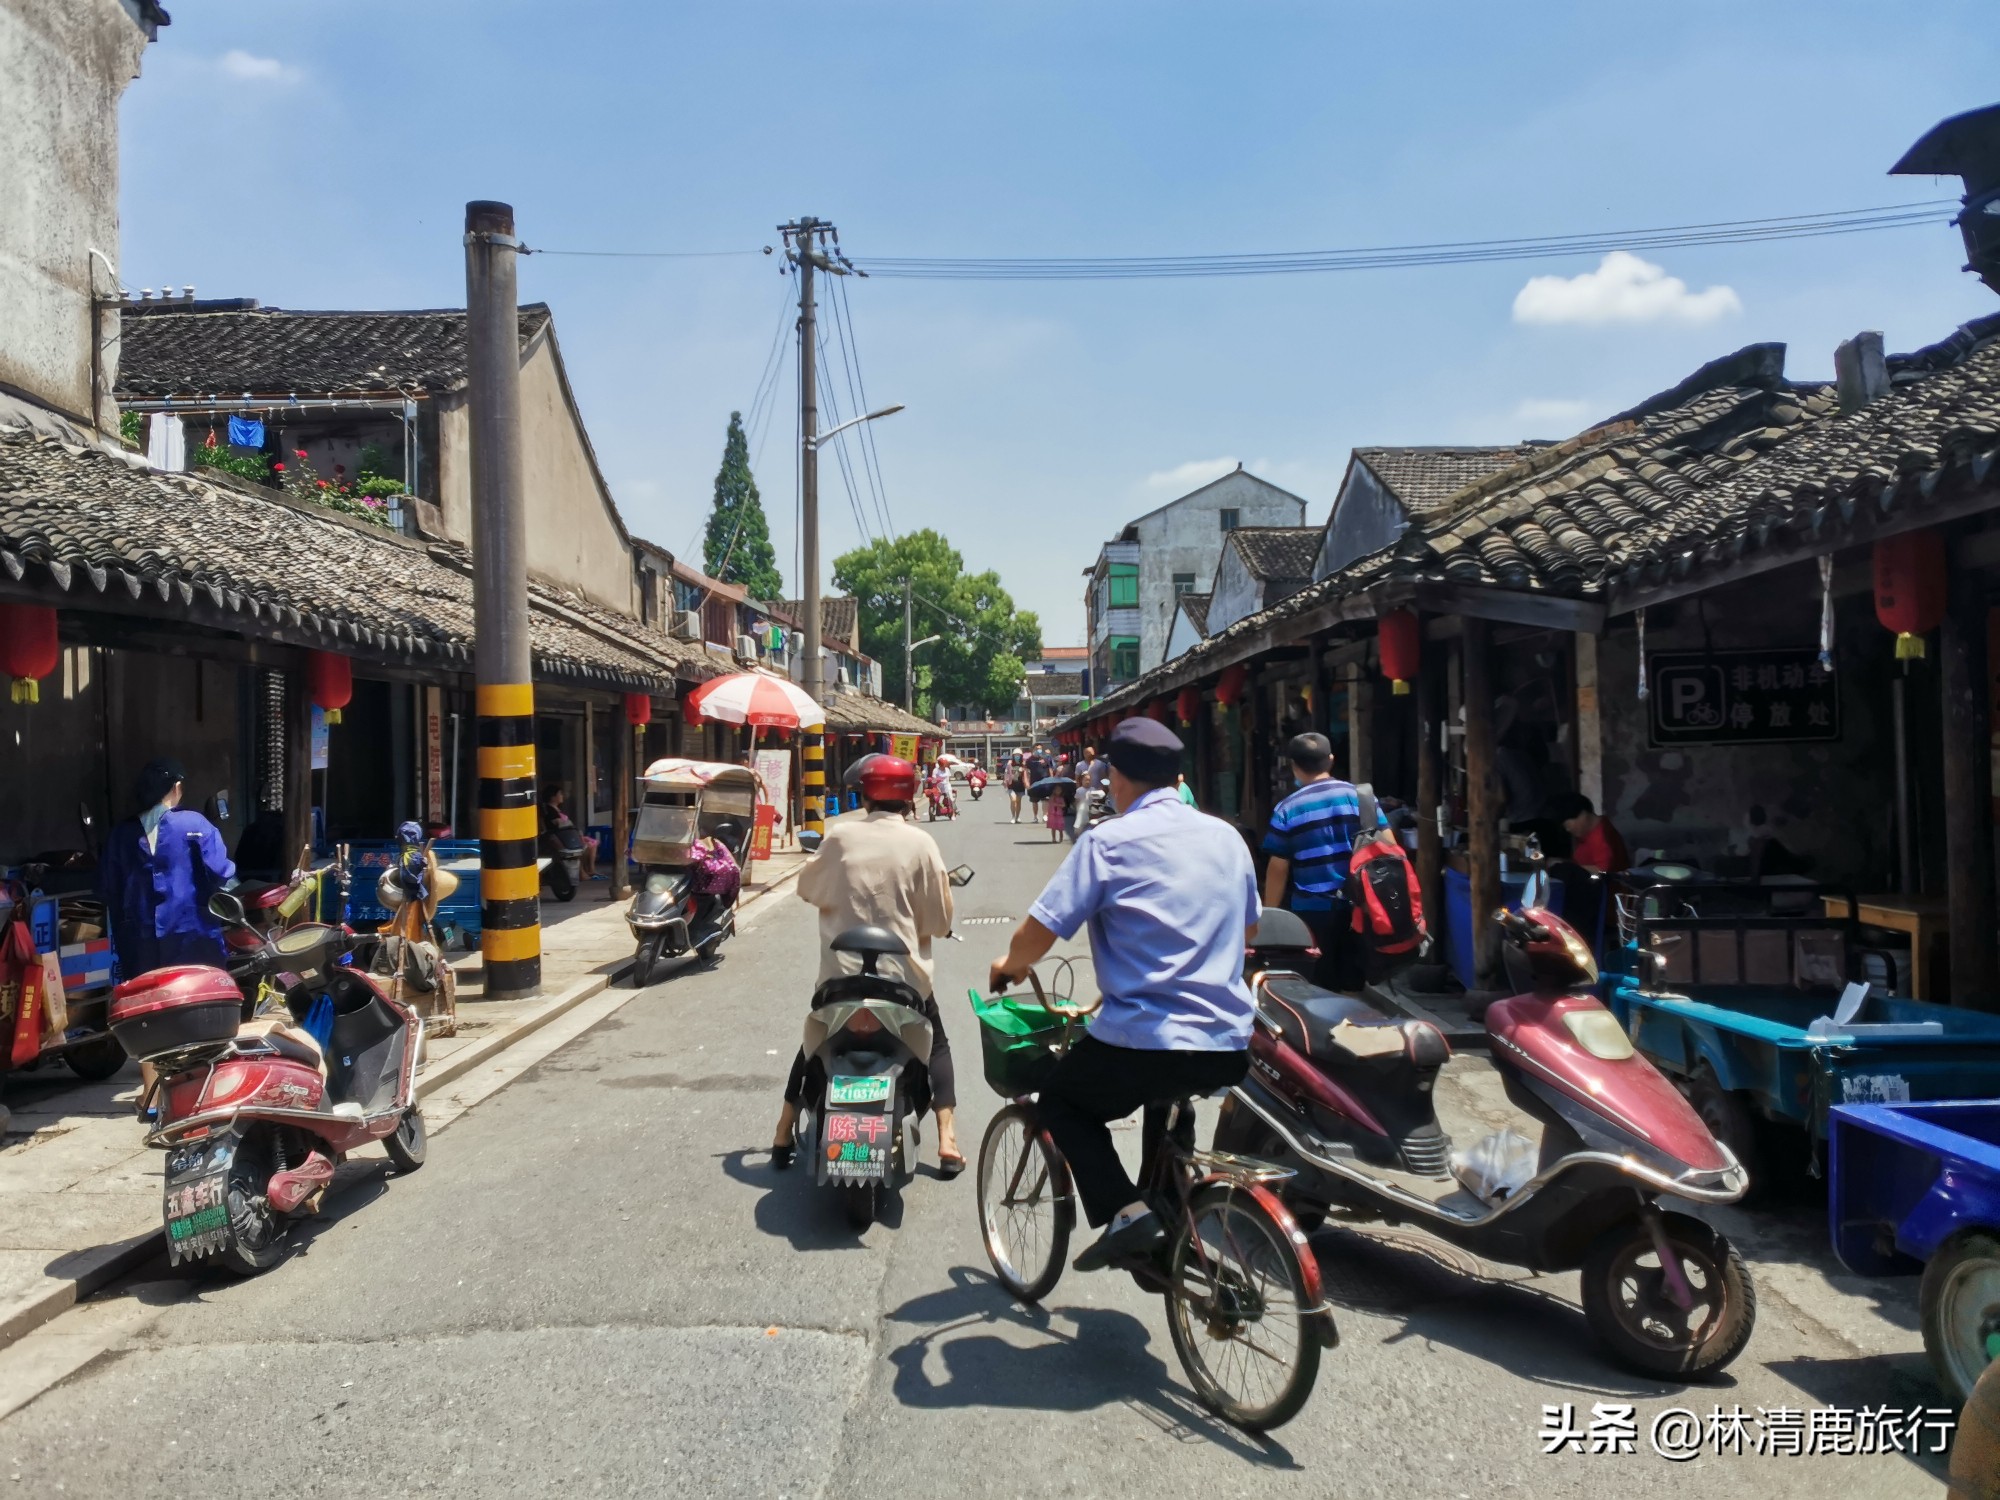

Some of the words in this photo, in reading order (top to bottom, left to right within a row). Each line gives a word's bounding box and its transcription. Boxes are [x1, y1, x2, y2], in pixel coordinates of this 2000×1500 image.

[1731, 662, 1828, 691] 非机动车
[1672, 677, 1705, 719] P
[1730, 701, 1830, 729] 停放处
[840, 1142, 869, 1162] 雅迪
[167, 1176, 224, 1220] 五鑫车行
